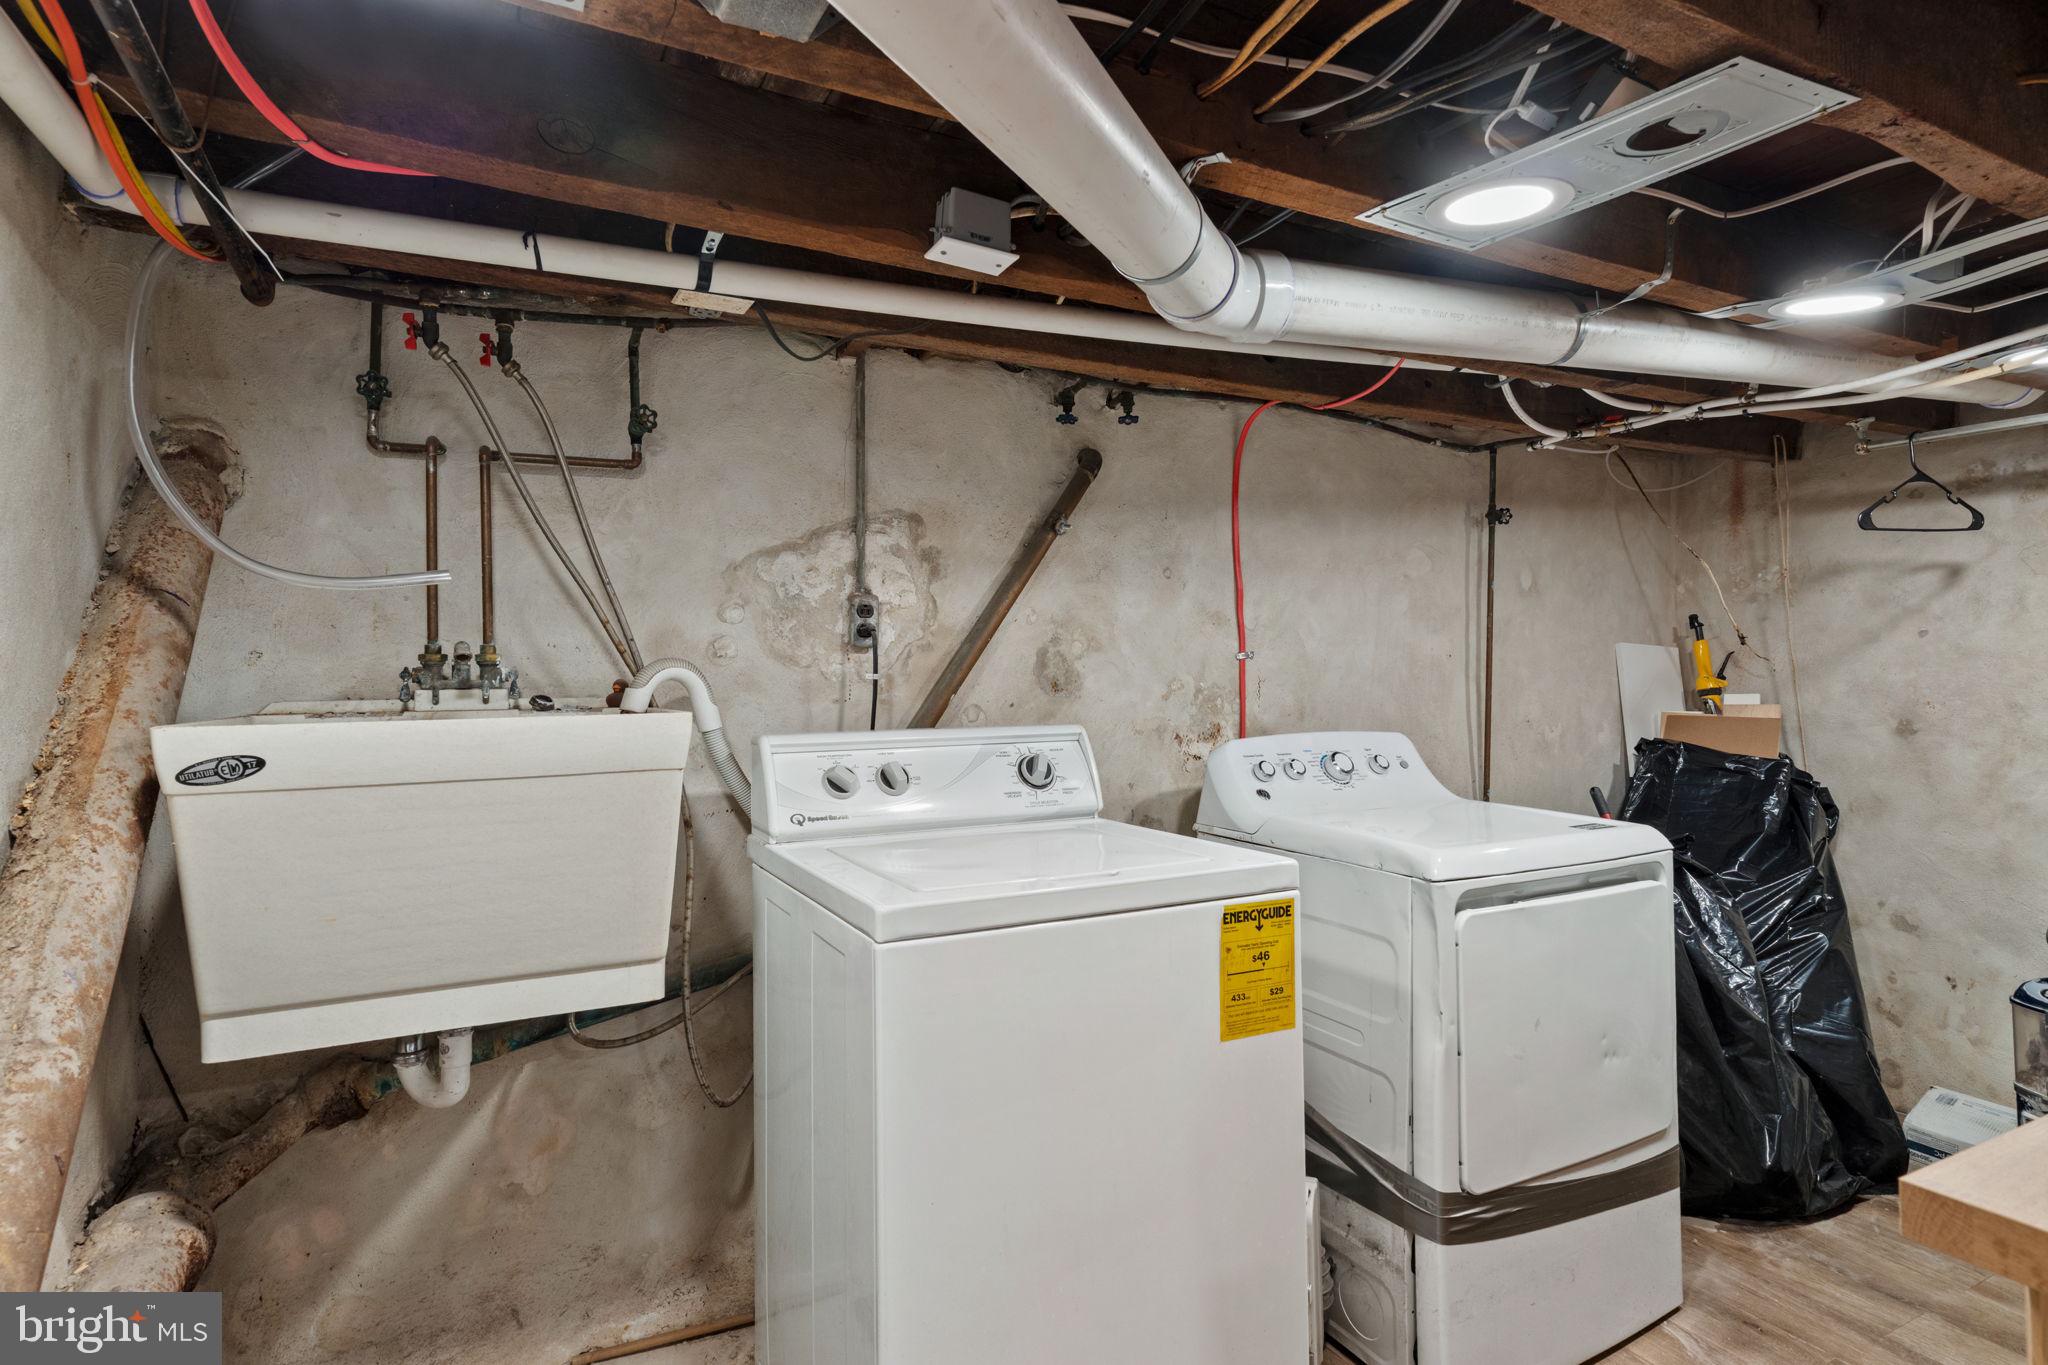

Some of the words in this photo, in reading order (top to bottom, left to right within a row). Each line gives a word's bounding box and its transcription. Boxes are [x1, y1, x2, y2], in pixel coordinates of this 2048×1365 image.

[247, 761, 257, 769] 17
[179, 770, 215, 781] UTILATUB
[1223, 905, 1291, 924] ENERGYGUIDE
[1252, 950, 1270, 962] $46
[1269, 986, 1284, 996] $29
[1231, 993, 1246, 1002] 433
